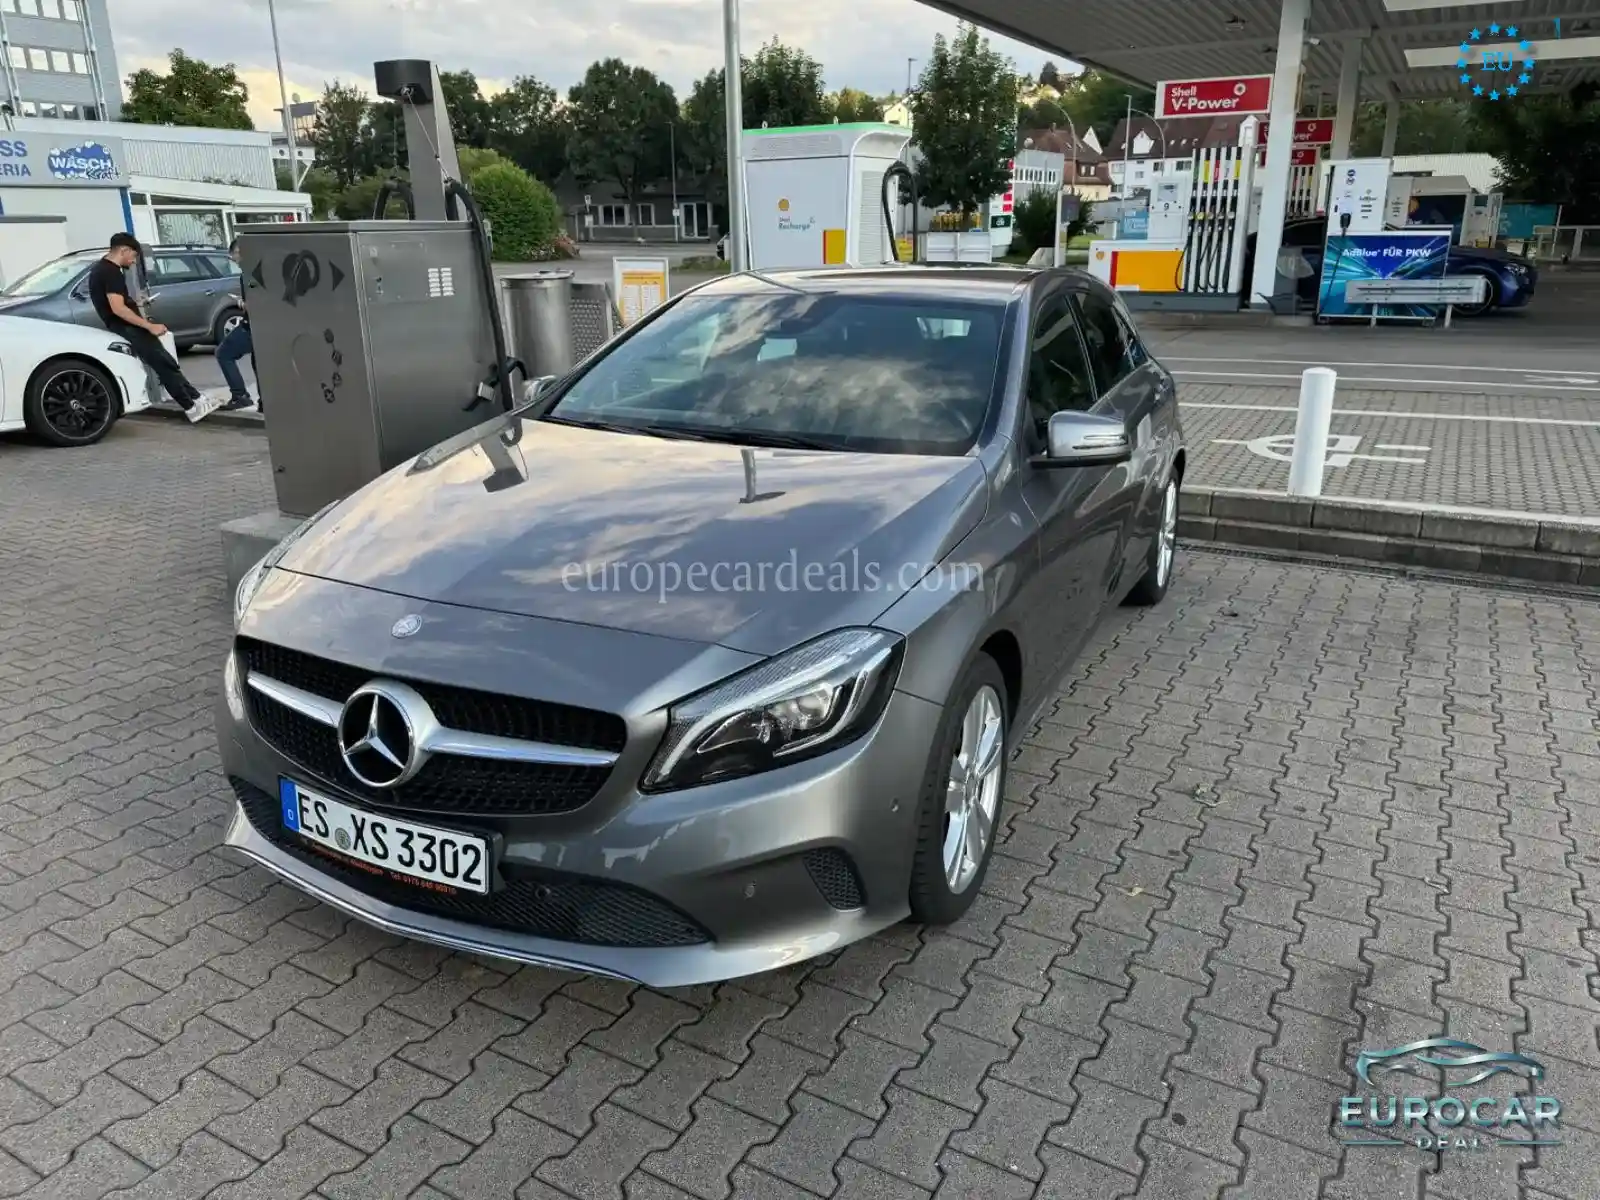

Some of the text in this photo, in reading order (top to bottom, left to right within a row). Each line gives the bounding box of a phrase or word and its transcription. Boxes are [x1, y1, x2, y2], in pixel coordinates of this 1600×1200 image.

[1171, 86, 1197, 97] Shell
[1171, 98, 1239, 111] V-Power
[0, 163, 31, 177] RIA
[1164, 202, 1170, 210] 9
[779, 222, 810, 231] Recharge
[1383, 246, 1402, 257] FÜR
[1406, 248, 1431, 257] PKW
[298, 791, 330, 838] ES
